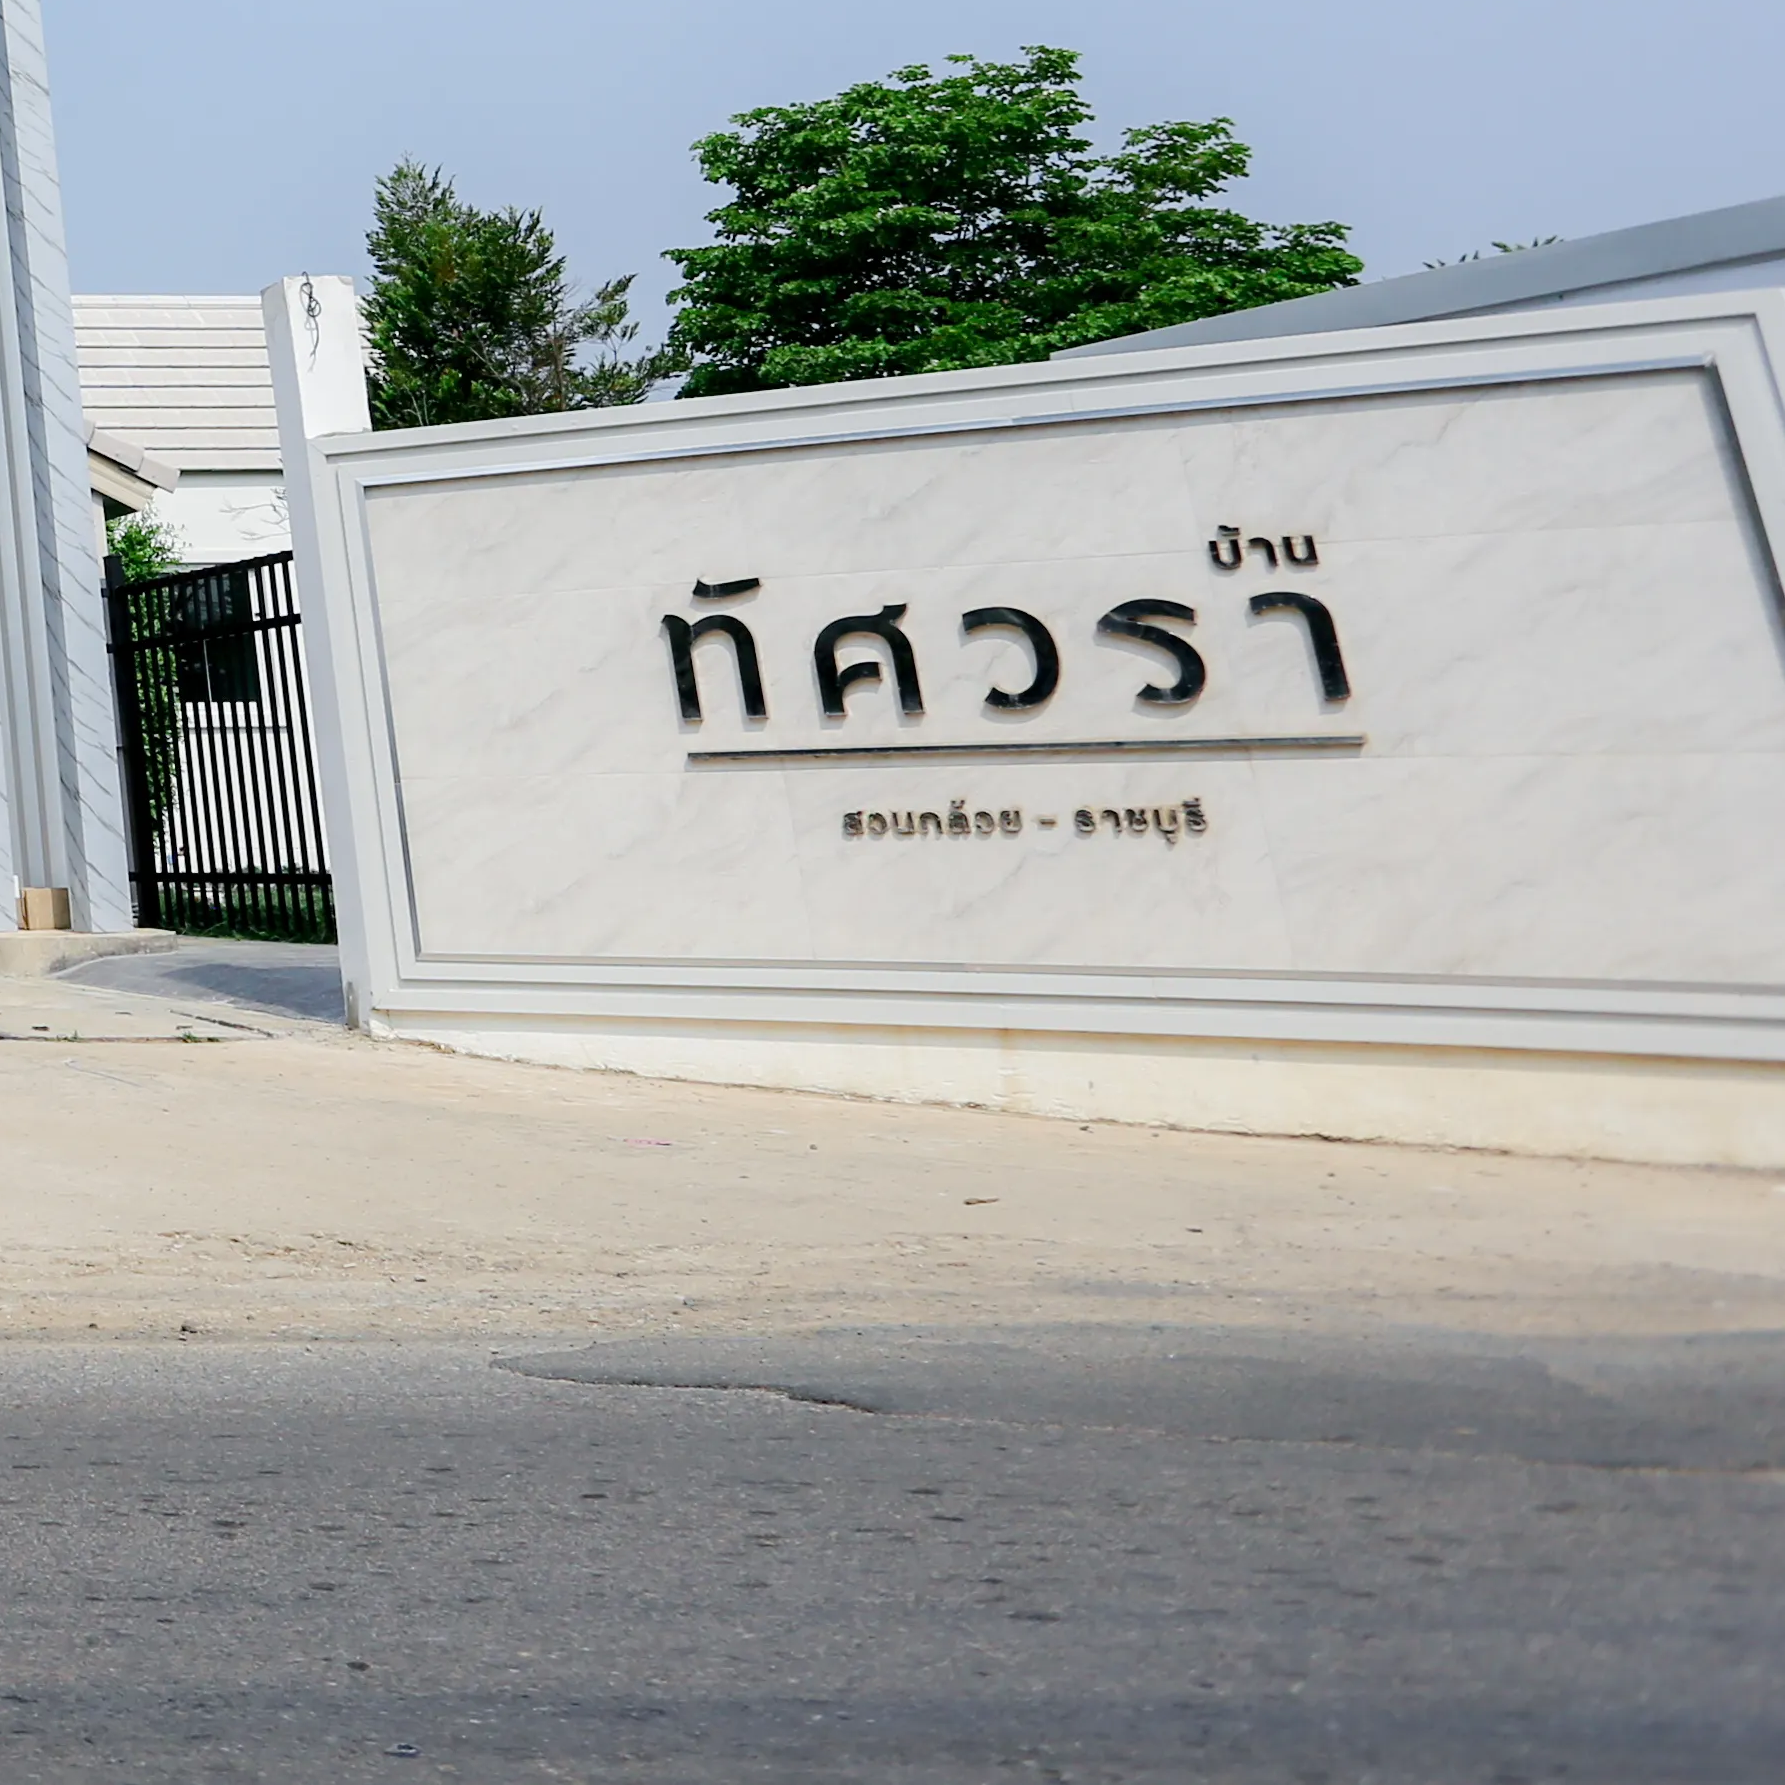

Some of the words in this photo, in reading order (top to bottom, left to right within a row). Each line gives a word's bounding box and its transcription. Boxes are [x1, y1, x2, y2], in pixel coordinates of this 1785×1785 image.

[1207, 524, 1319, 571] บ้าน
[660, 576, 1352, 721] ทัศวรา
[842, 799, 1023, 835] สวนกล้วย
[1074, 797, 1208, 845] ราชบุรี
